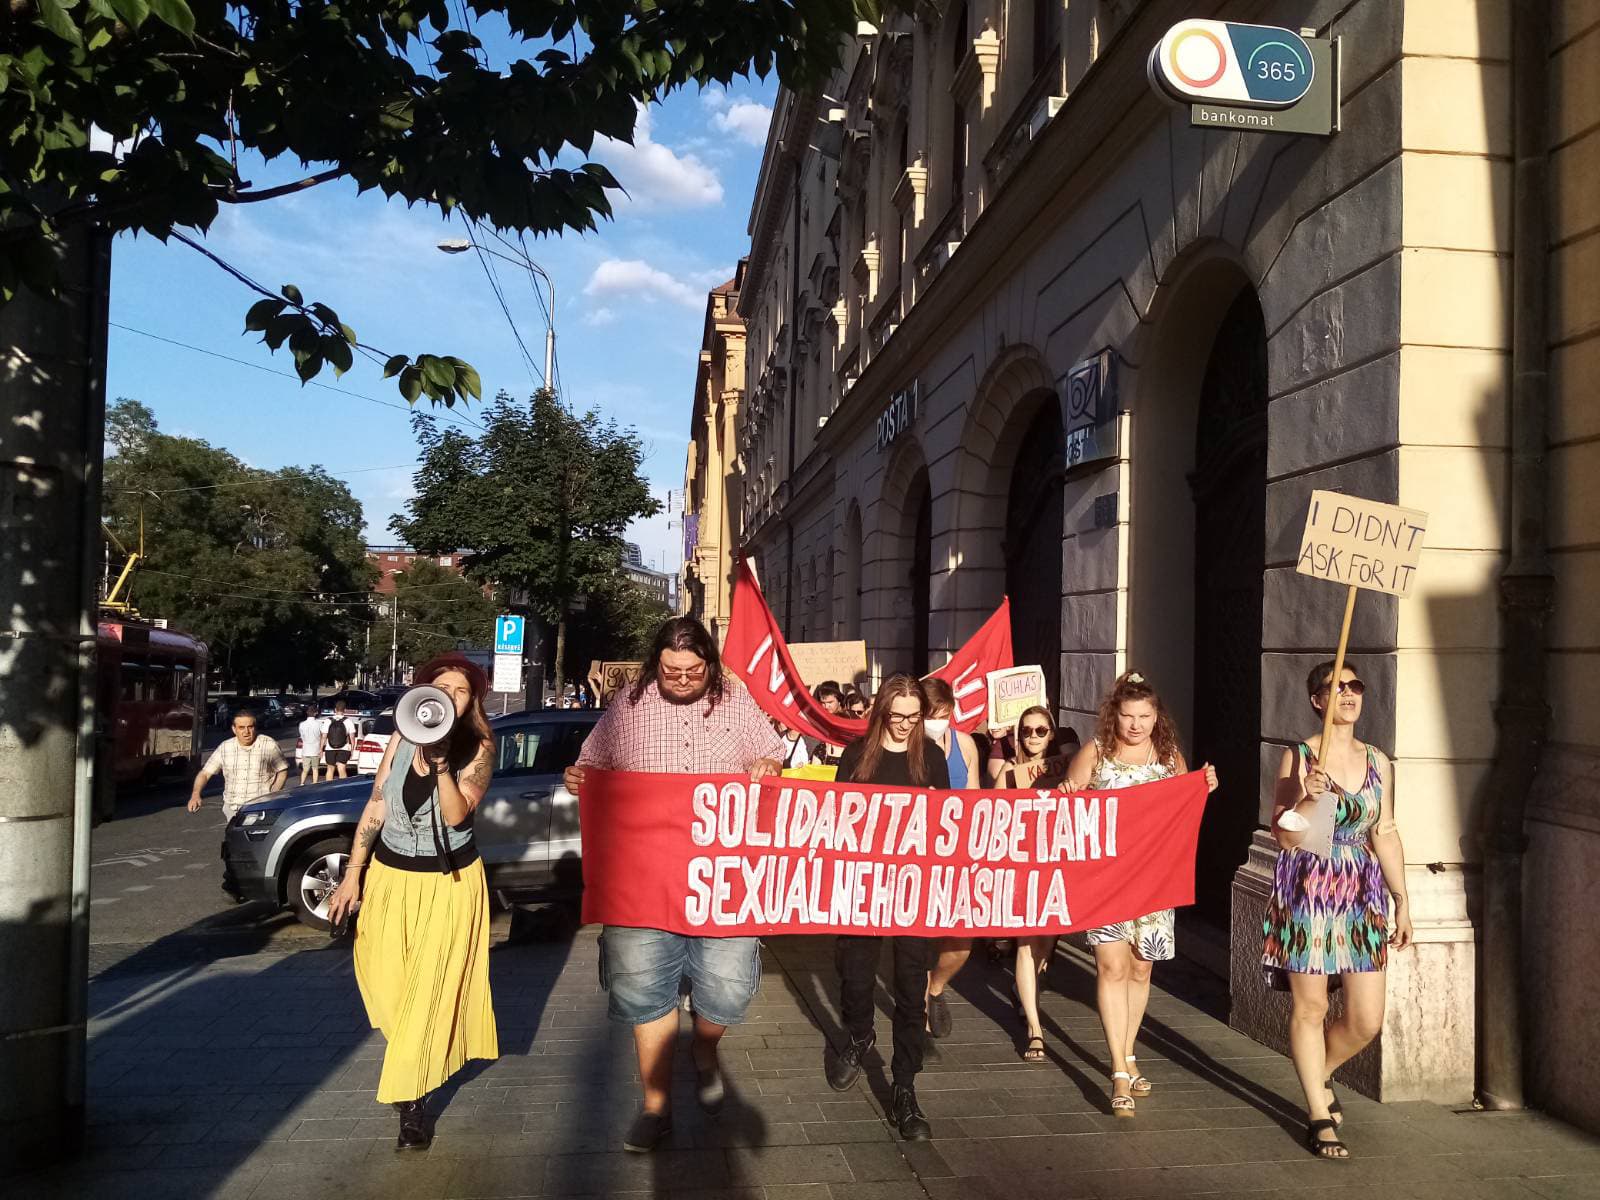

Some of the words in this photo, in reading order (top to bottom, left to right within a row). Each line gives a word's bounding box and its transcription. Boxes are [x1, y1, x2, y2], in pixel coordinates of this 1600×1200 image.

[1257, 61, 1295, 81] 365
[1201, 109, 1274, 126] bankomat
[876, 388, 908, 453] POŠTA
[1312, 500, 1319, 526] I
[1332, 507, 1425, 551] DIDN'T
[1298, 541, 1343, 579] ASK
[1348, 553, 1384, 588] FOR
[1392, 564, 1416, 591] IT
[503, 620, 516, 641] P
[691, 782, 927, 856] SOLIDARITA
[935, 796, 963, 857] S
[968, 790, 1118, 863] OBEŤAMI
[685, 849, 922, 927] SEXUÁLNEHO
[925, 863, 1072, 928] NÁSILIA
